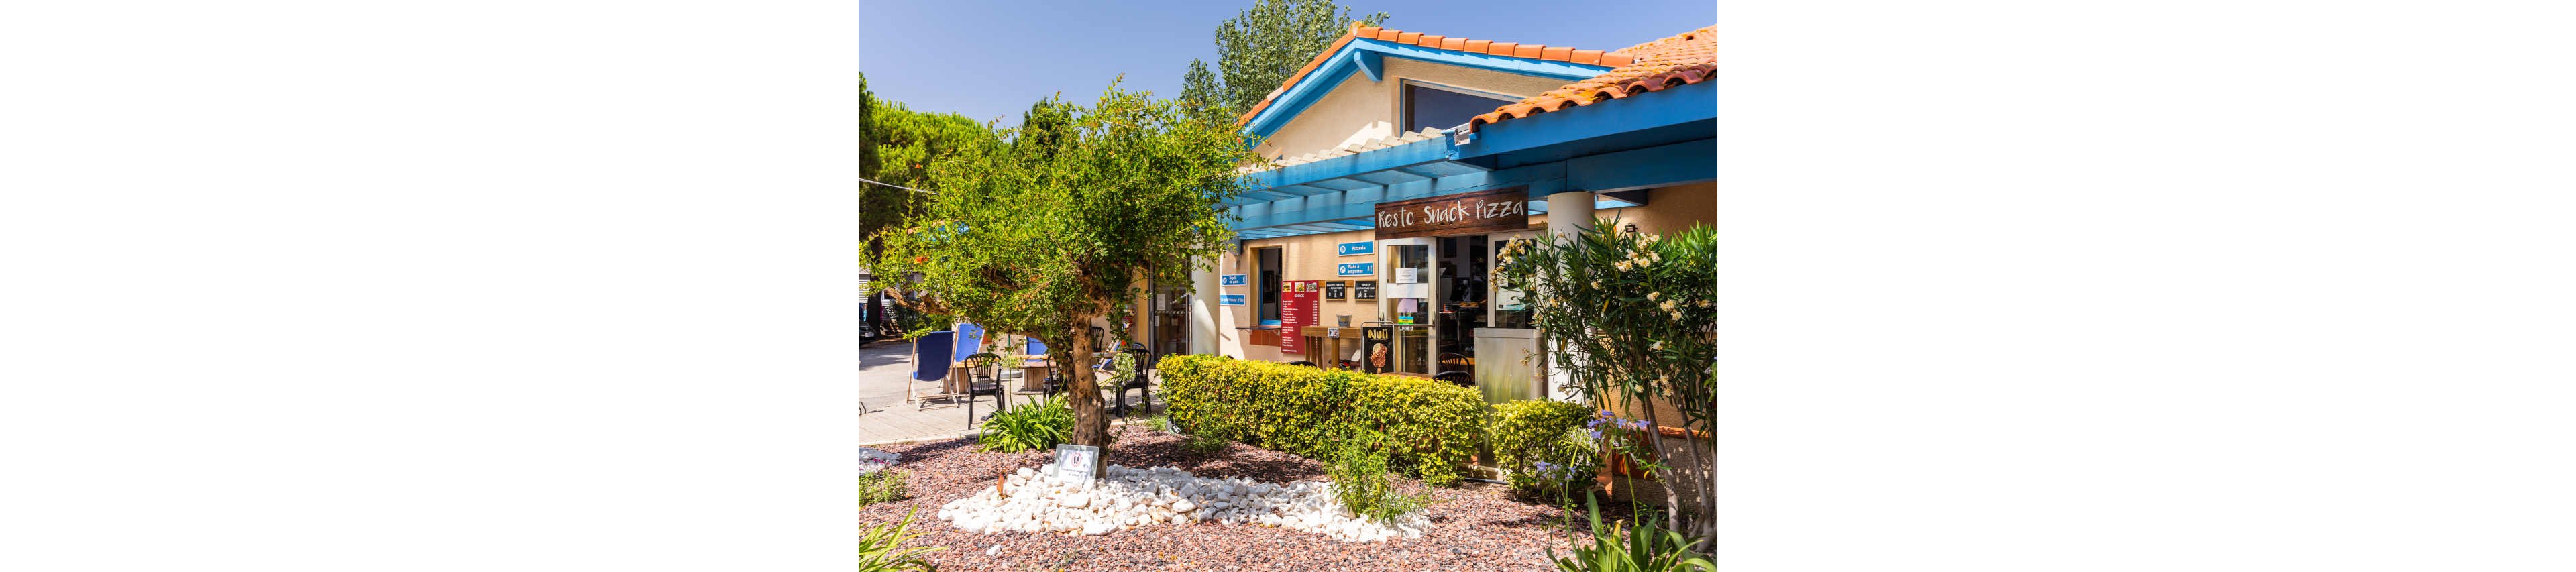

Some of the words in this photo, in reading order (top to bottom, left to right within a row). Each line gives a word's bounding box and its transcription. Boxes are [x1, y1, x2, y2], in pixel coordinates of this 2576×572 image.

[1378, 206, 1414, 229] Resto
[1424, 199, 1470, 225] Snack
[1475, 199, 1524, 221] Pizza
